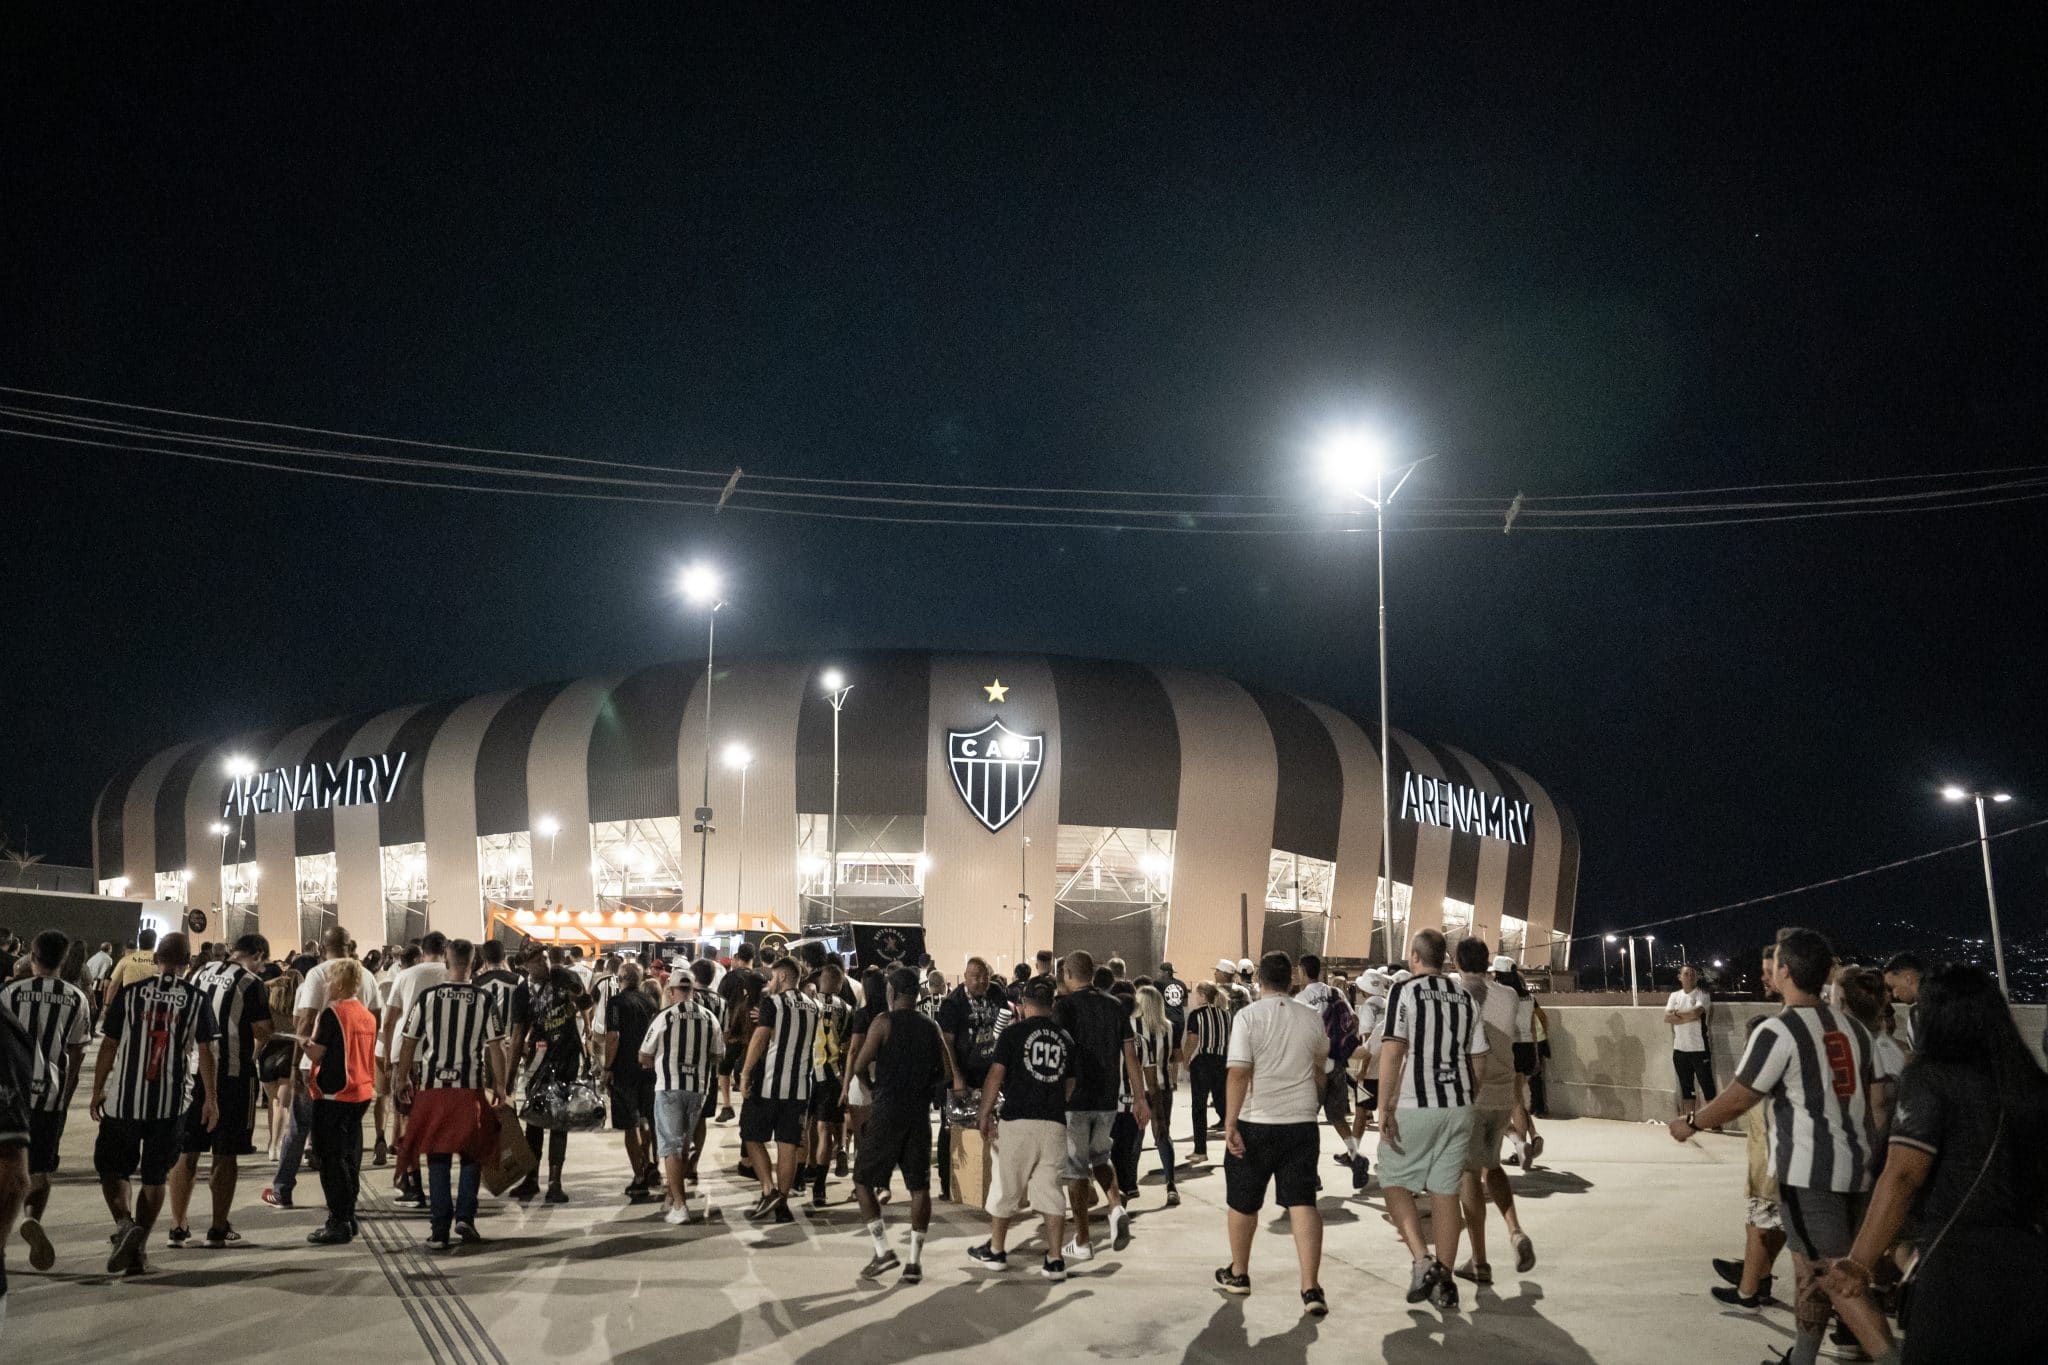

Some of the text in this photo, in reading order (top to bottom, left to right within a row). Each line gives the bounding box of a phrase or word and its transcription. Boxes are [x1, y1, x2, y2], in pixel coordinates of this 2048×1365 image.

[152, 988, 186, 1008] bmg
[447, 989, 474, 1003] bmg
[1032, 1041, 1061, 1069] C13
